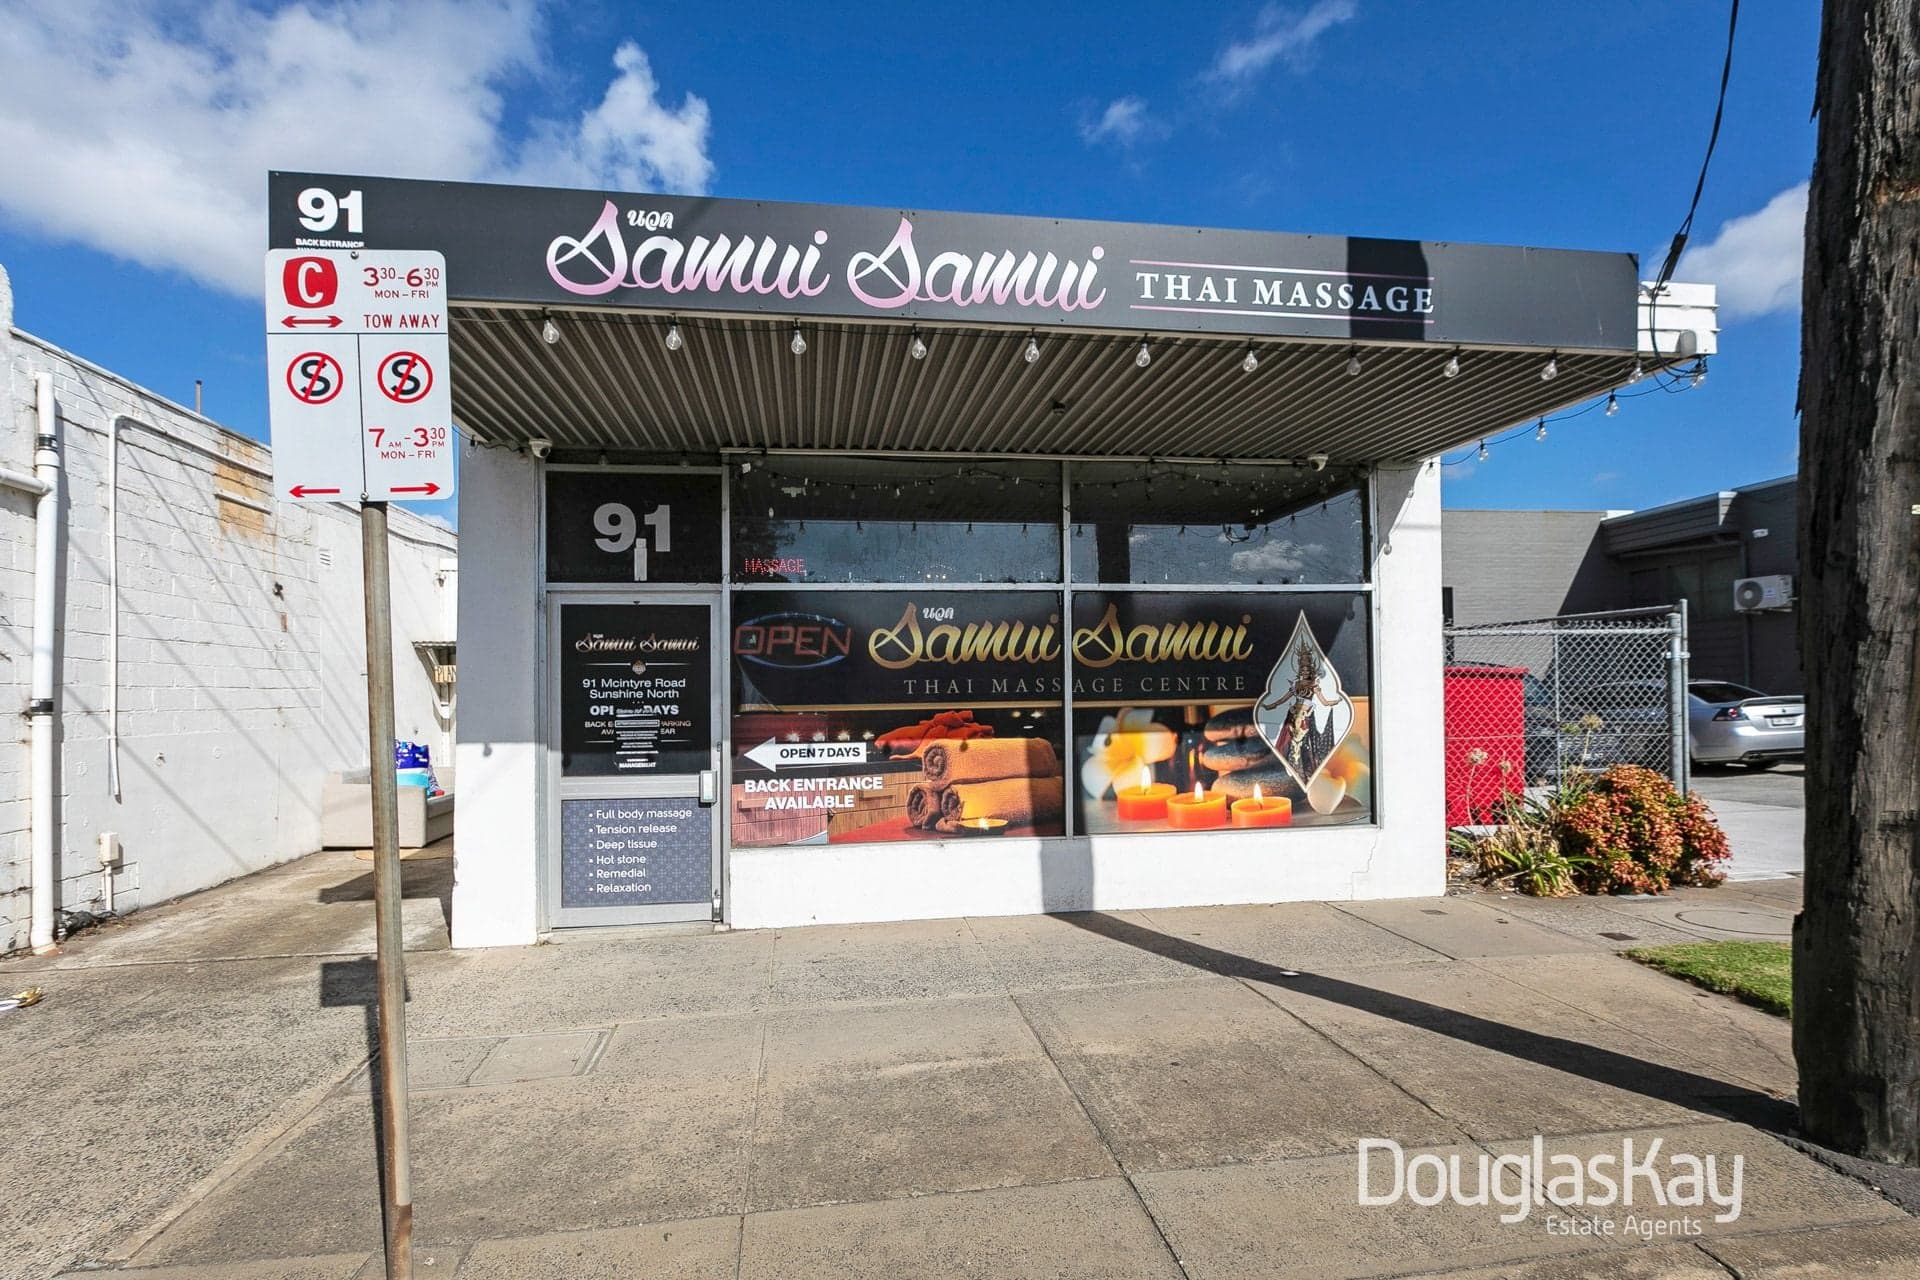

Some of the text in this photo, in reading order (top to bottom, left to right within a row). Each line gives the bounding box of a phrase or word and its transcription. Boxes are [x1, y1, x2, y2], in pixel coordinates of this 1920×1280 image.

[297, 188, 363, 233] 91
[295, 237, 364, 249] BACK ENTRANCE
[546, 200, 1106, 312] Samui Samui
[374, 290, 399, 298] MON
[411, 290, 429, 298] FRI
[1136, 272, 1435, 314] THAI MASSAGE
[363, 314, 440, 328] TOW AWAY
[381, 451, 405, 459] MON
[417, 450, 436, 459] FRI
[593, 502, 671, 552] 91
[744, 558, 806, 575] MASSAGE
[734, 625, 851, 656] OPEN
[868, 602, 1254, 669] Samui Samui
[582, 678, 597, 688] 91
[655, 678, 686, 688] Road
[904, 676, 1245, 695] THAI MASSAGE CENTRE
[589, 688, 680, 699] Sunshine North
[780, 747, 861, 759] OPEN 7 DAYS
[744, 776, 884, 793] BACK ENTRANCE
[764, 795, 856, 810] AVAILABLE
[596, 809, 692, 820] Full body massage
[595, 824, 677, 834] Tension release
[596, 839, 658, 851] Deep tissue
[596, 855, 647, 865] Hot stone
[596, 868, 646, 879] Remedial
[596, 883, 652, 893] Relaxation
